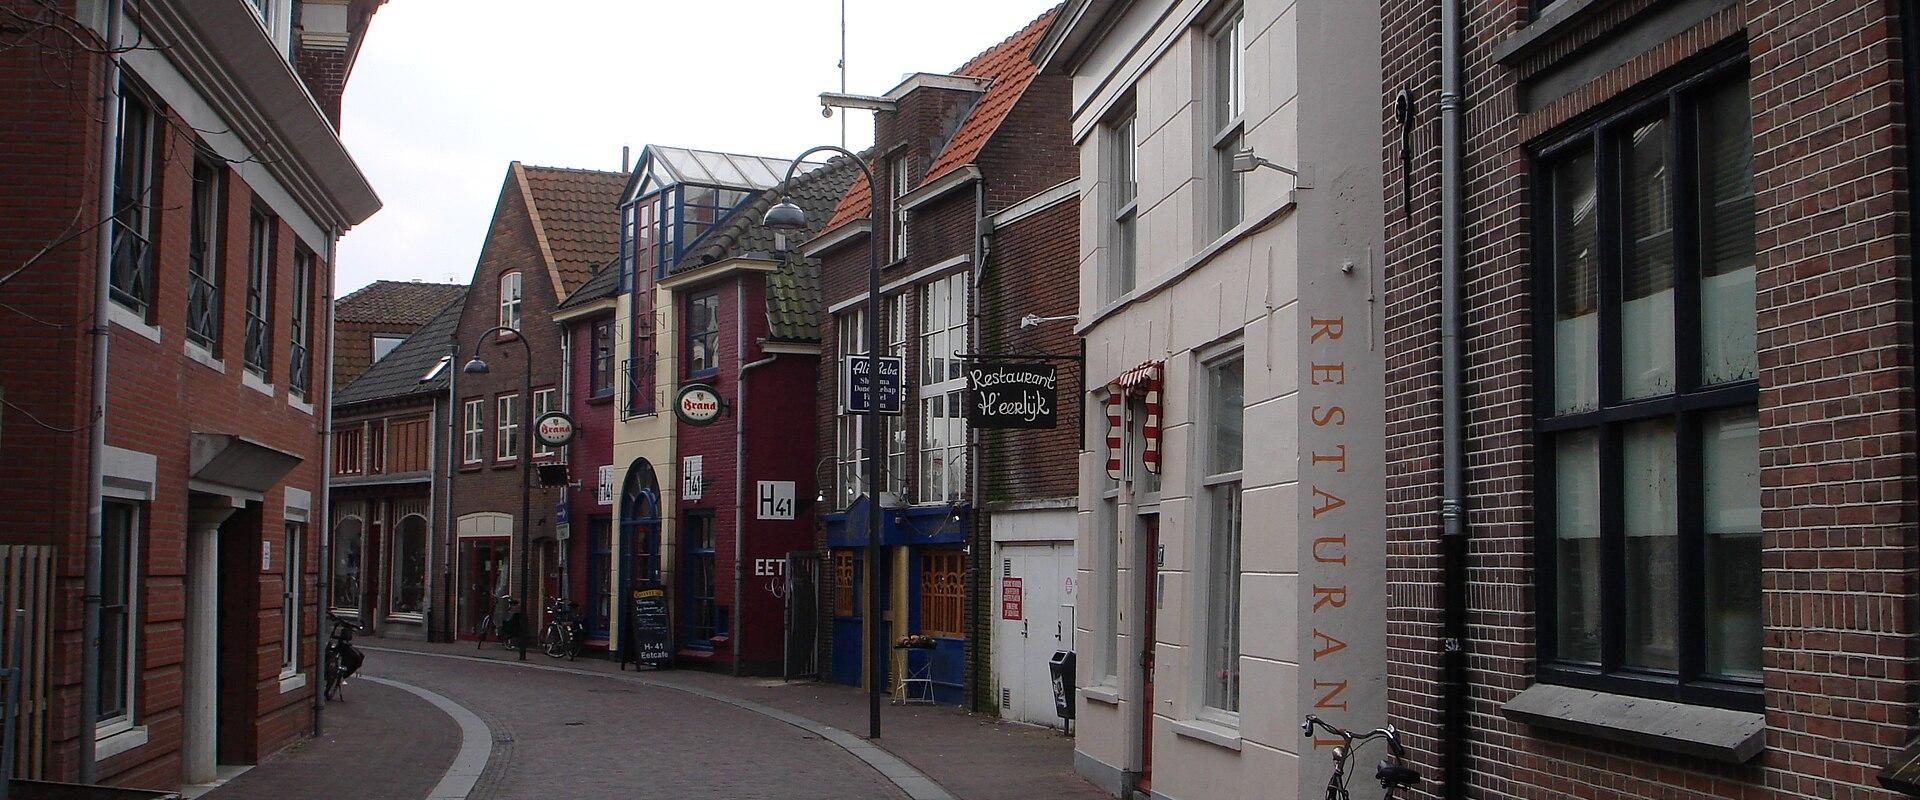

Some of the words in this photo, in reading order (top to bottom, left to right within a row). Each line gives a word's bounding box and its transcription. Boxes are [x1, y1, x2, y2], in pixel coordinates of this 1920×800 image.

[852, 361, 870, 375] Ali
[970, 366, 1056, 391] Restaurant
[684, 398, 716, 411] Brand
[541, 423, 571, 434] Brand
